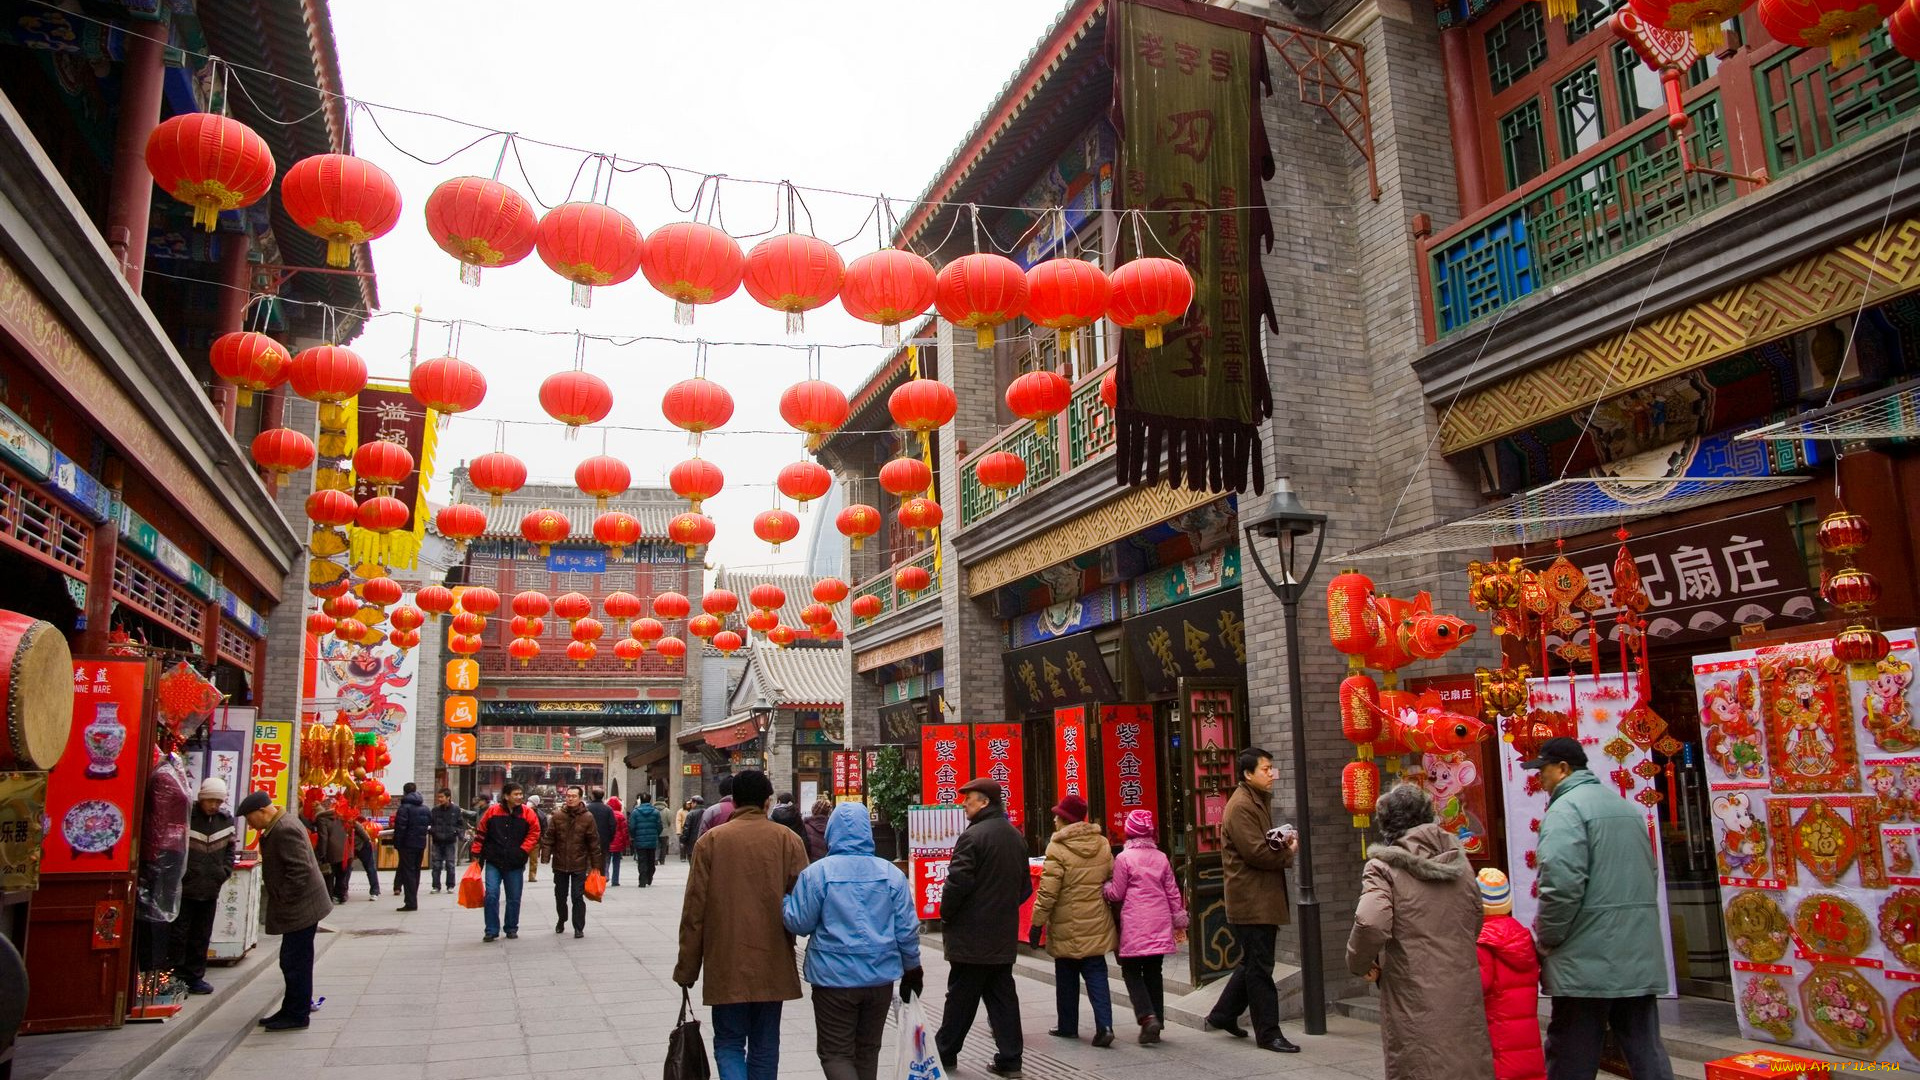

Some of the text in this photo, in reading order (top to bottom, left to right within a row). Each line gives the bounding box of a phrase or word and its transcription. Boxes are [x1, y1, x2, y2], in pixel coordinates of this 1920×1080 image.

[1138, 33, 1233, 82] 老字号
[1557, 574, 1572, 588] 福
[1571, 535, 1780, 619] 星记扇庄
[1147, 610, 1246, 678] 紫金堂
[93, 685, 111, 694] WARE
[1018, 650, 1093, 702] 紫金堂
[935, 740, 958, 804] 紫金堂
[1116, 723, 1143, 806] 紫金堂
